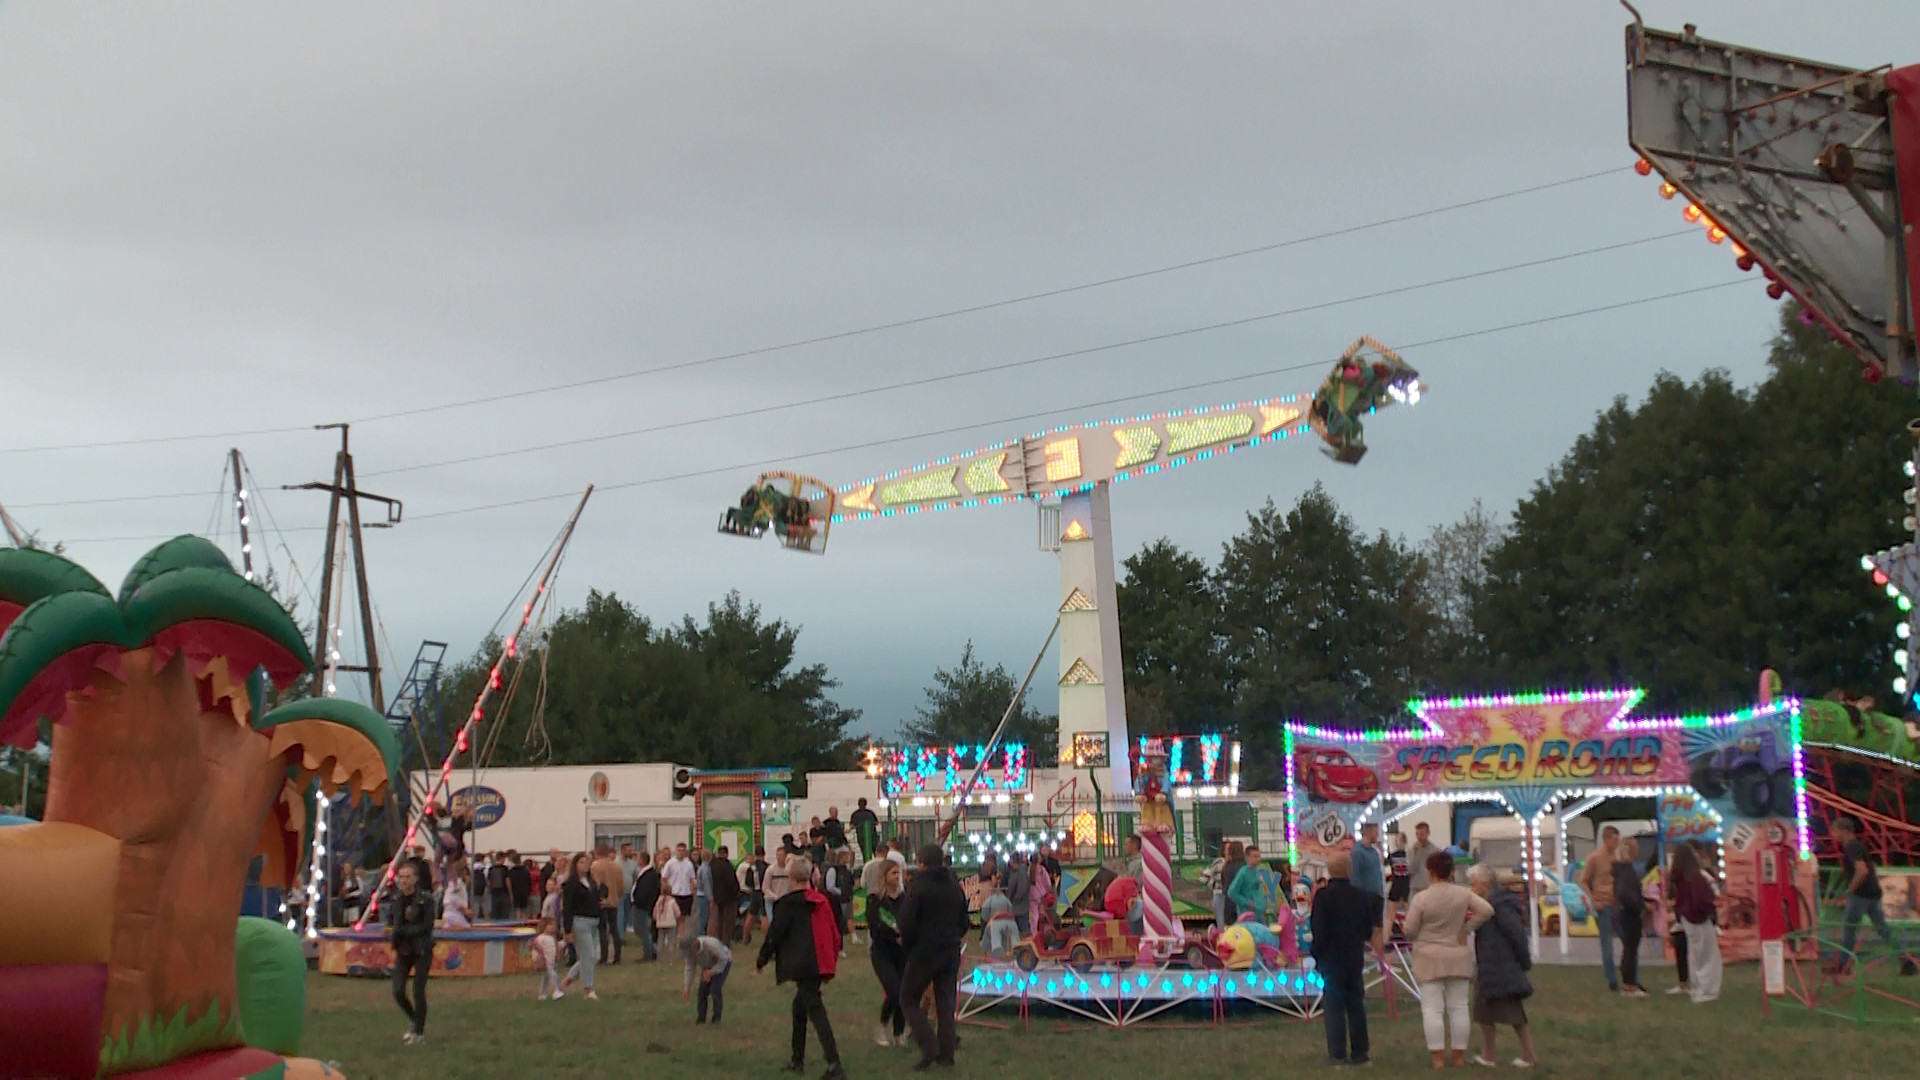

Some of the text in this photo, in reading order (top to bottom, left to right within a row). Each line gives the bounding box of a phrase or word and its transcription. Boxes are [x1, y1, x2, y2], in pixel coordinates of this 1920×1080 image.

[1387, 736, 1663, 783] SPEED ROAD
[1323, 817, 1342, 842] 66
